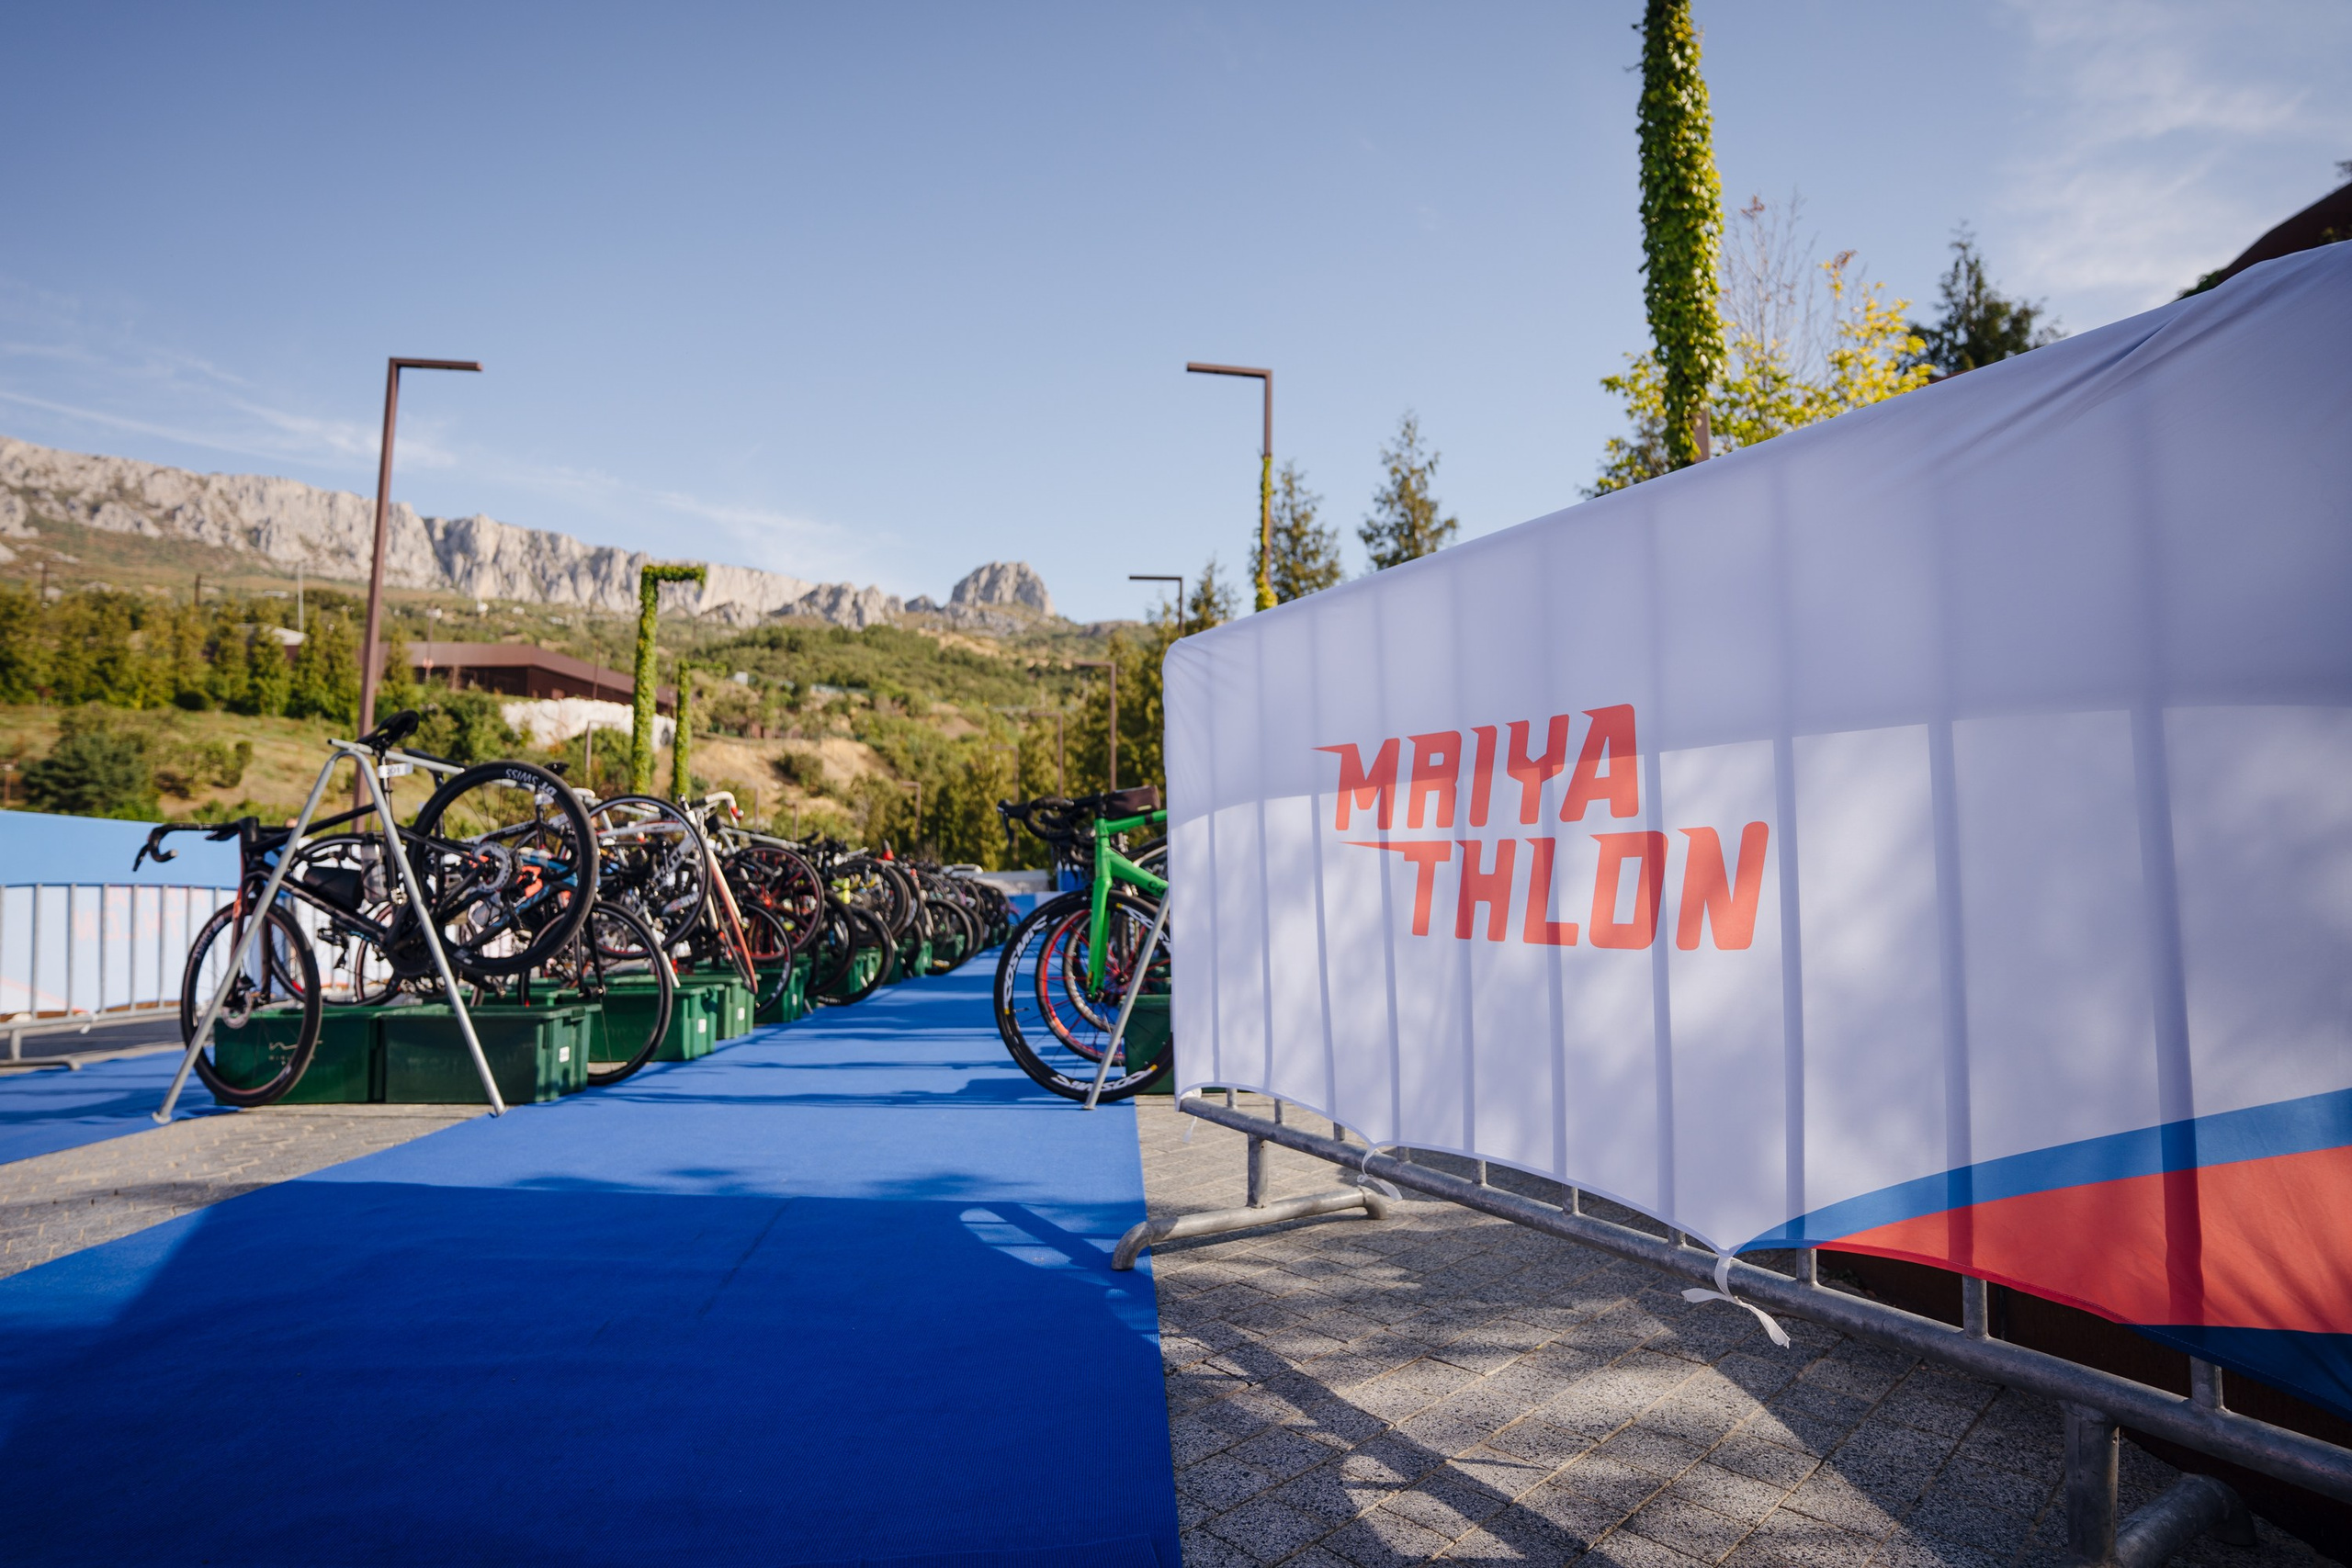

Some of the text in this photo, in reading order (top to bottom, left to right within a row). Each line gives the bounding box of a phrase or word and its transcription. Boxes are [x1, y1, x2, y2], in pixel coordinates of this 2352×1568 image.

[505, 768, 558, 796] DT SWISS
[1310, 704, 1639, 831] MRIYA
[1338, 821, 1769, 951] THLON
